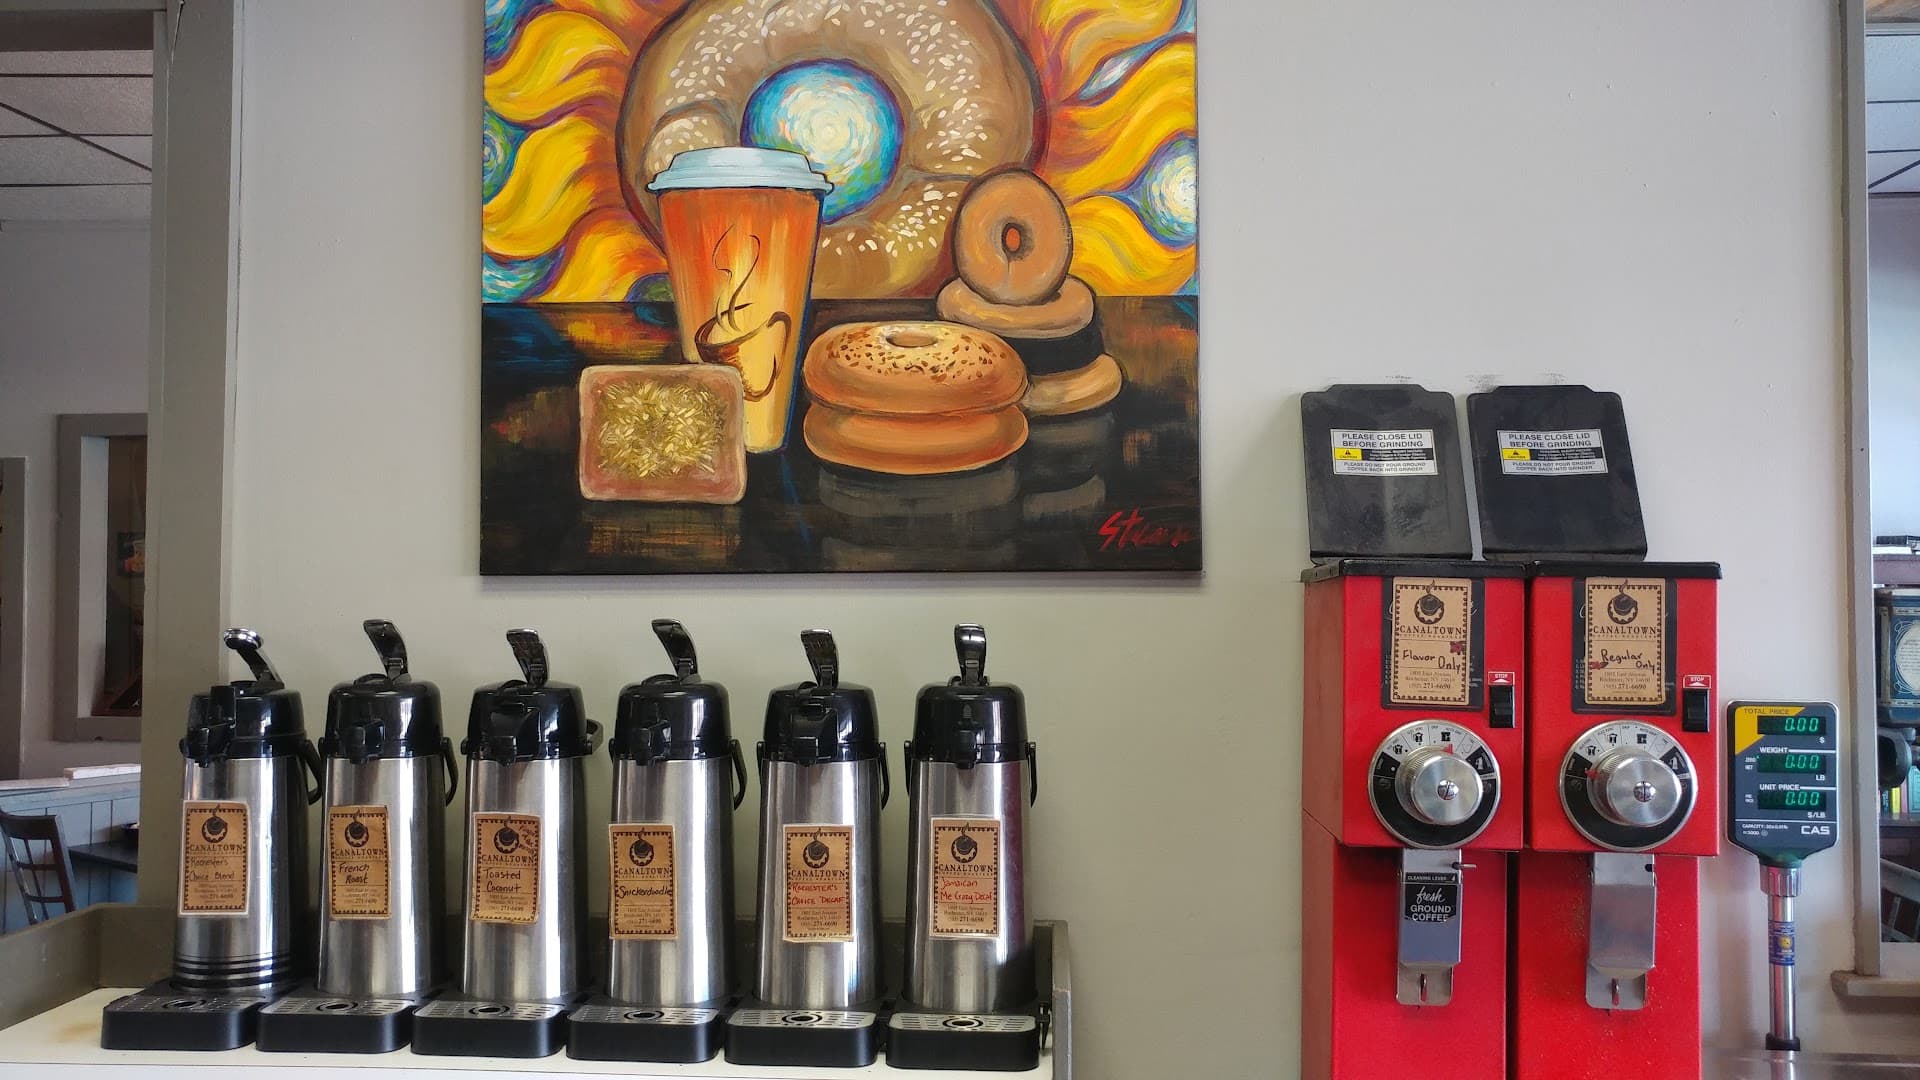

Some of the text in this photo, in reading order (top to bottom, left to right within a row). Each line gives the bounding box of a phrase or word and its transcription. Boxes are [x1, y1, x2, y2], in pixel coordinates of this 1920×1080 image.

[1400, 625, 1462, 635] CANALTOWN
[1593, 626, 1656, 635] CANALTOWN
[1403, 649, 1435, 661] Flavor
[1601, 649, 1642, 664] Regular
[1438, 656, 1461, 674] Only
[1636, 661, 1655, 675] Only
[1785, 718, 1819, 731] 0.00
[1785, 754, 1819, 769] 0.00
[1786, 792, 1819, 805] 0.00
[1801, 826, 1830, 835] CAS
[335, 848, 384, 856] CANALTOWN
[482, 855, 534, 863] CANALTOWN
[339, 862, 369, 872] French
[939, 864, 993, 872] CANALTOWN
[346, 873, 368, 884] Roast
[482, 868, 521, 879] Toasted
[486, 880, 522, 893] Coconut
[941, 877, 977, 890] Jamaican
[619, 885, 673, 899] Snickerdoodle
[941, 892, 952, 901] Me
[1416, 886, 1446, 904] fresh
[1410, 904, 1451, 913] GROUND
[1412, 913, 1449, 922] COFFEE
